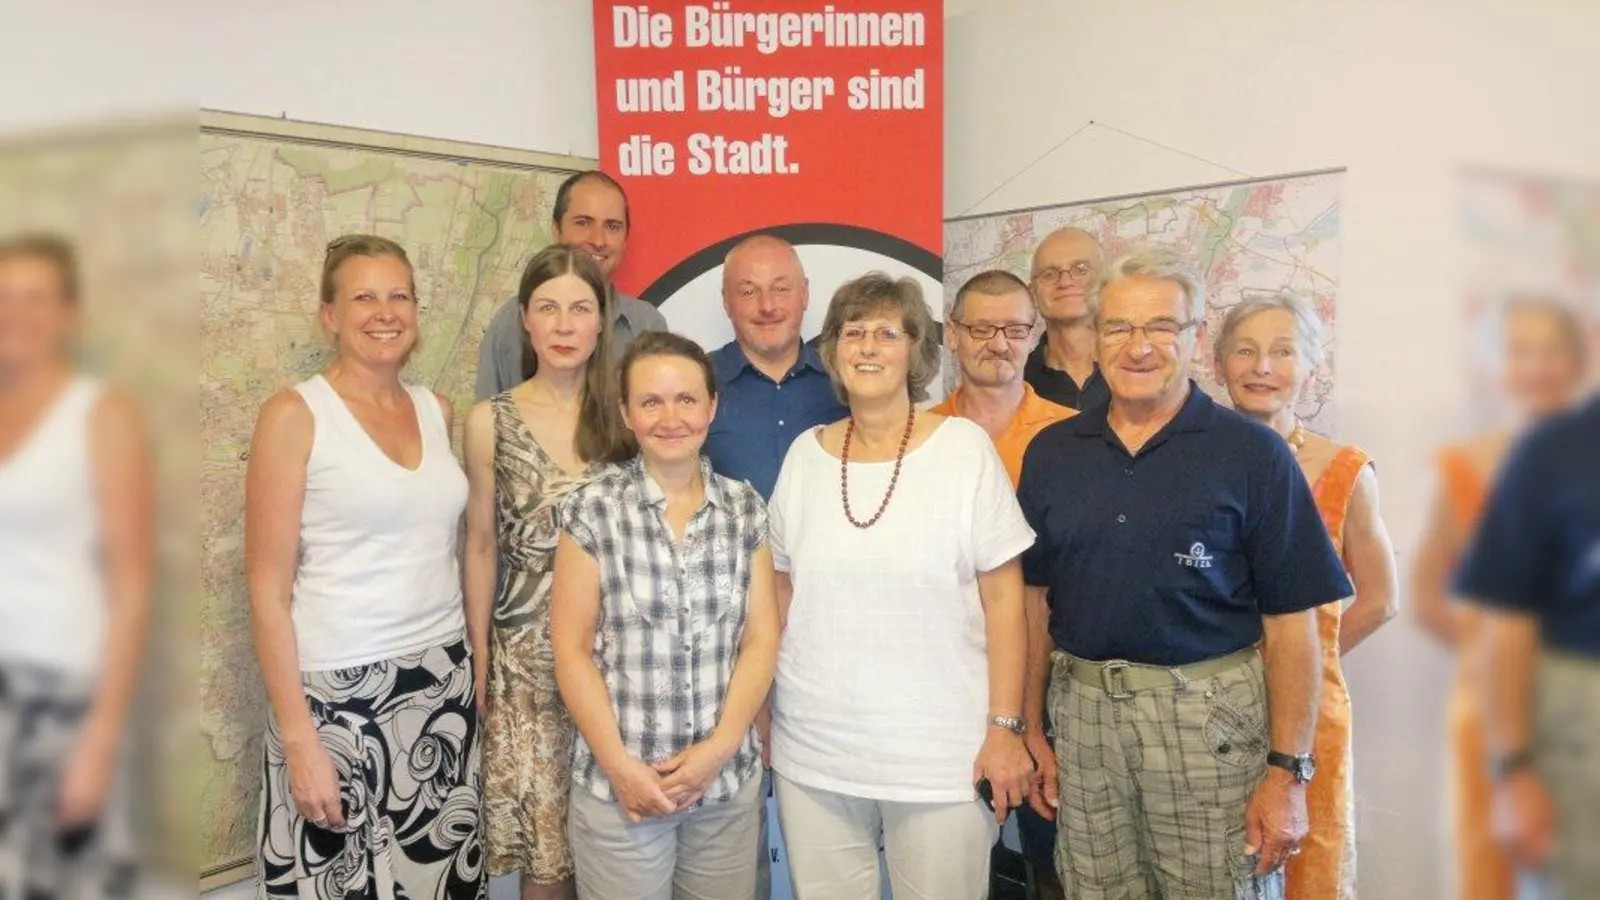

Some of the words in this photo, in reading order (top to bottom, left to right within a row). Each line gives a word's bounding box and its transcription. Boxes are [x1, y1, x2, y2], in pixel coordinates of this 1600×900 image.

[613, 6, 672, 48] Die
[686, 2, 925, 54] Bürgerinnen
[616, 70, 685, 112] und
[697, 66, 834, 117] Bürger
[848, 69, 924, 110] sind
[618, 135, 674, 176] die
[687, 133, 799, 176] Stadt.
